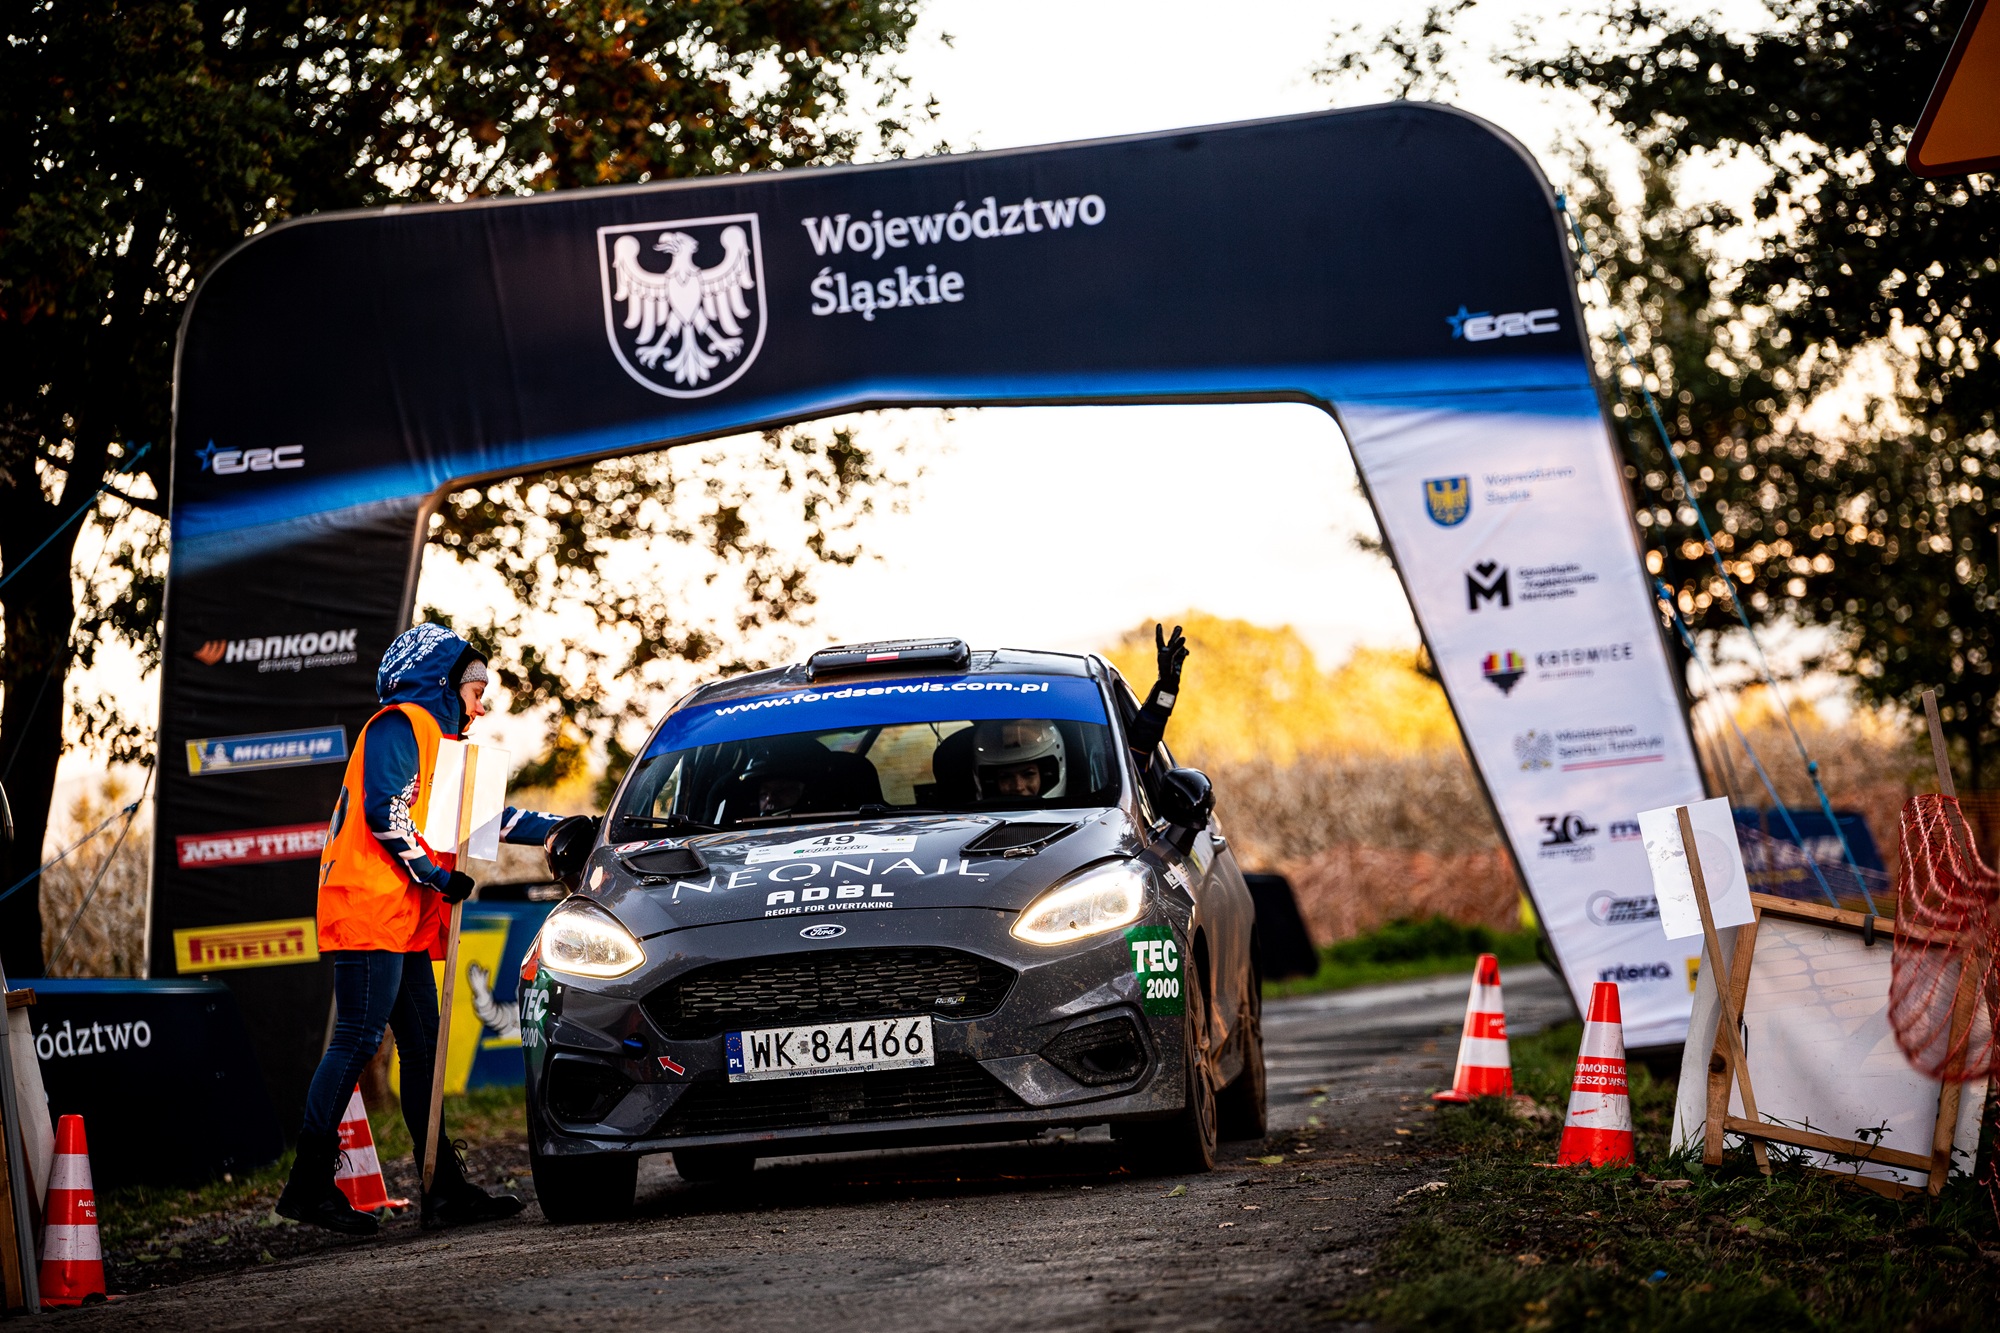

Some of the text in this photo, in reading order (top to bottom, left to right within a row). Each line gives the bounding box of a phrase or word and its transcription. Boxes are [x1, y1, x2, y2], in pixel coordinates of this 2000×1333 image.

[802, 194, 1106, 260] Województwo
[810, 264, 965, 321] Śląskie
[1463, 308, 1560, 342] ERC
[212, 444, 305, 475] ERC
[714, 681, 1050, 717] www.fordserwis.com.pl
[233, 737, 333, 762] MICHELIN
[182, 839, 257, 864] MRF
[812, 835, 856, 846] 49
[764, 901, 894, 917] RECIPE FOR OVERTAKING
[766, 883, 895, 906] ADBL
[188, 928, 304, 964] PIRELLI
[1132, 939, 1178, 973] TEC
[1146, 978, 1179, 999] 2000
[521, 988, 549, 1022] TEC
[33, 1019, 152, 1060] ództwo
[522, 1027, 539, 1048] 2000
[750, 1020, 924, 1068] WK 84466
[729, 1058, 743, 1068] PL
[788, 1063, 875, 1077] www.fordserwis.com.pl
